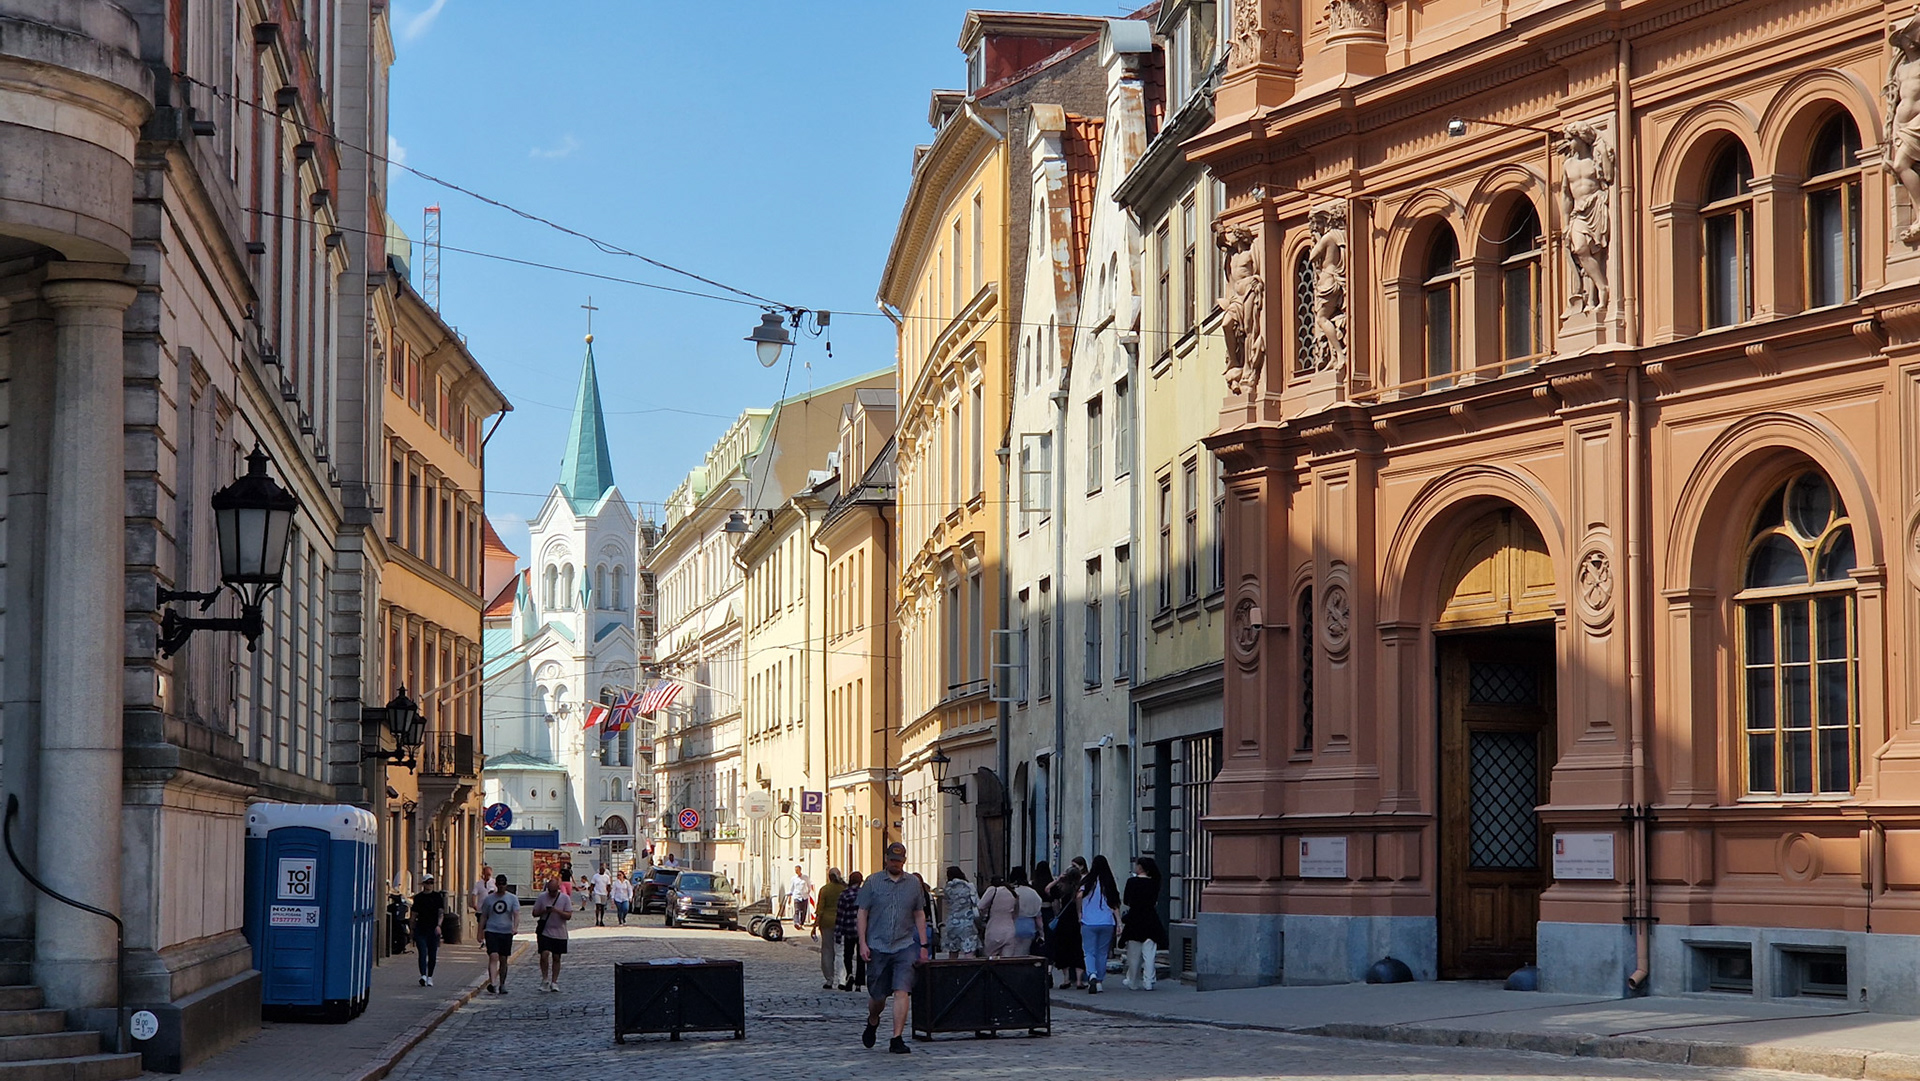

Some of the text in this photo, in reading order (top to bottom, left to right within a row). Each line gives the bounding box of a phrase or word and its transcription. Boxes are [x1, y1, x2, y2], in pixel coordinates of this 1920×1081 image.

[806, 794, 818, 810] P
[287, 866, 311, 882] TOI
[287, 882, 310, 894] TOI
